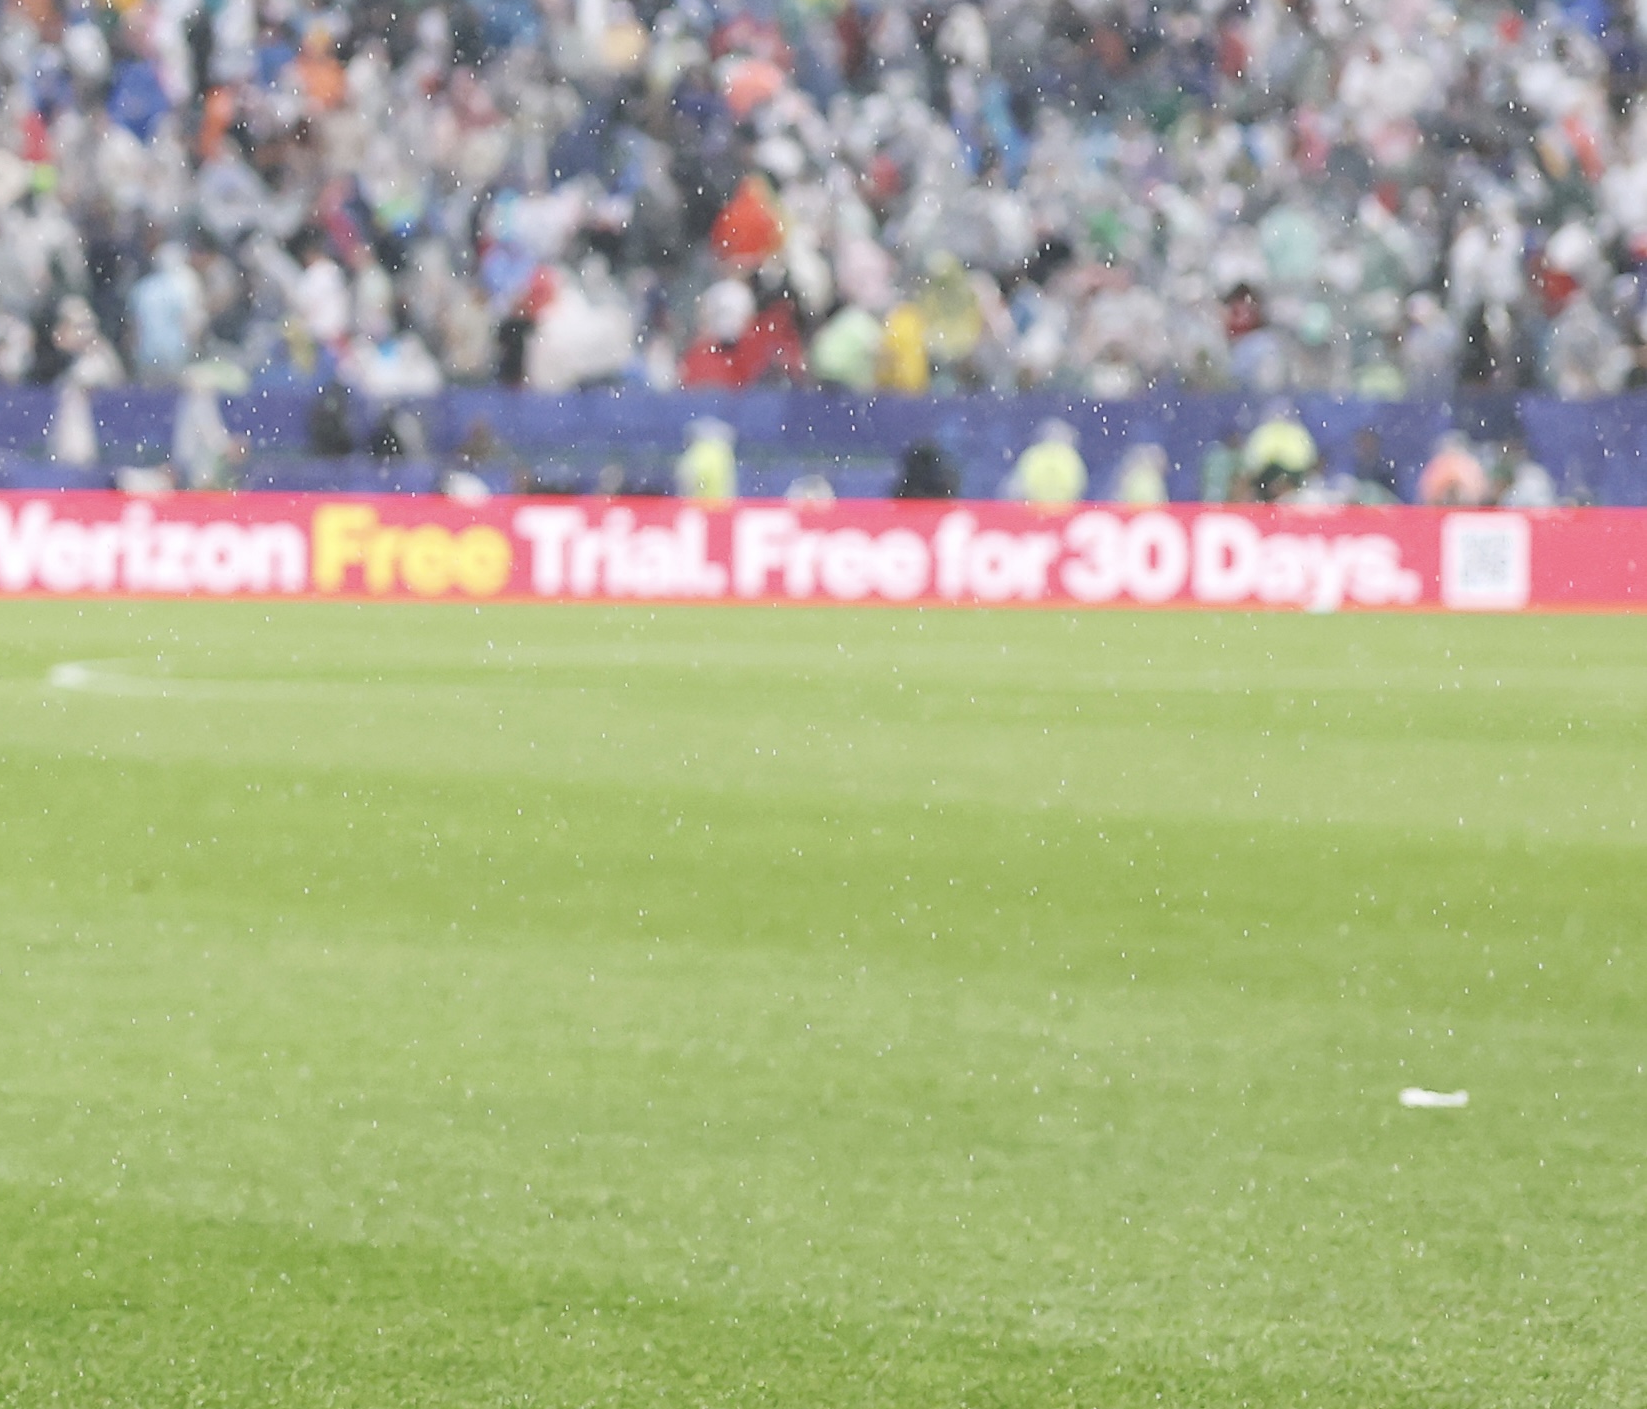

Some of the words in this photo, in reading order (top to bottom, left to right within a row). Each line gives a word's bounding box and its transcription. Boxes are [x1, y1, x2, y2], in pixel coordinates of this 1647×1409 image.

[314, 504, 510, 593] Free
[515, 506, 727, 595] Trial.
[732, 509, 930, 599] Free
[937, 512, 1059, 600] for
[1062, 512, 1187, 601] 30
[1194, 515, 1420, 612] Days.
